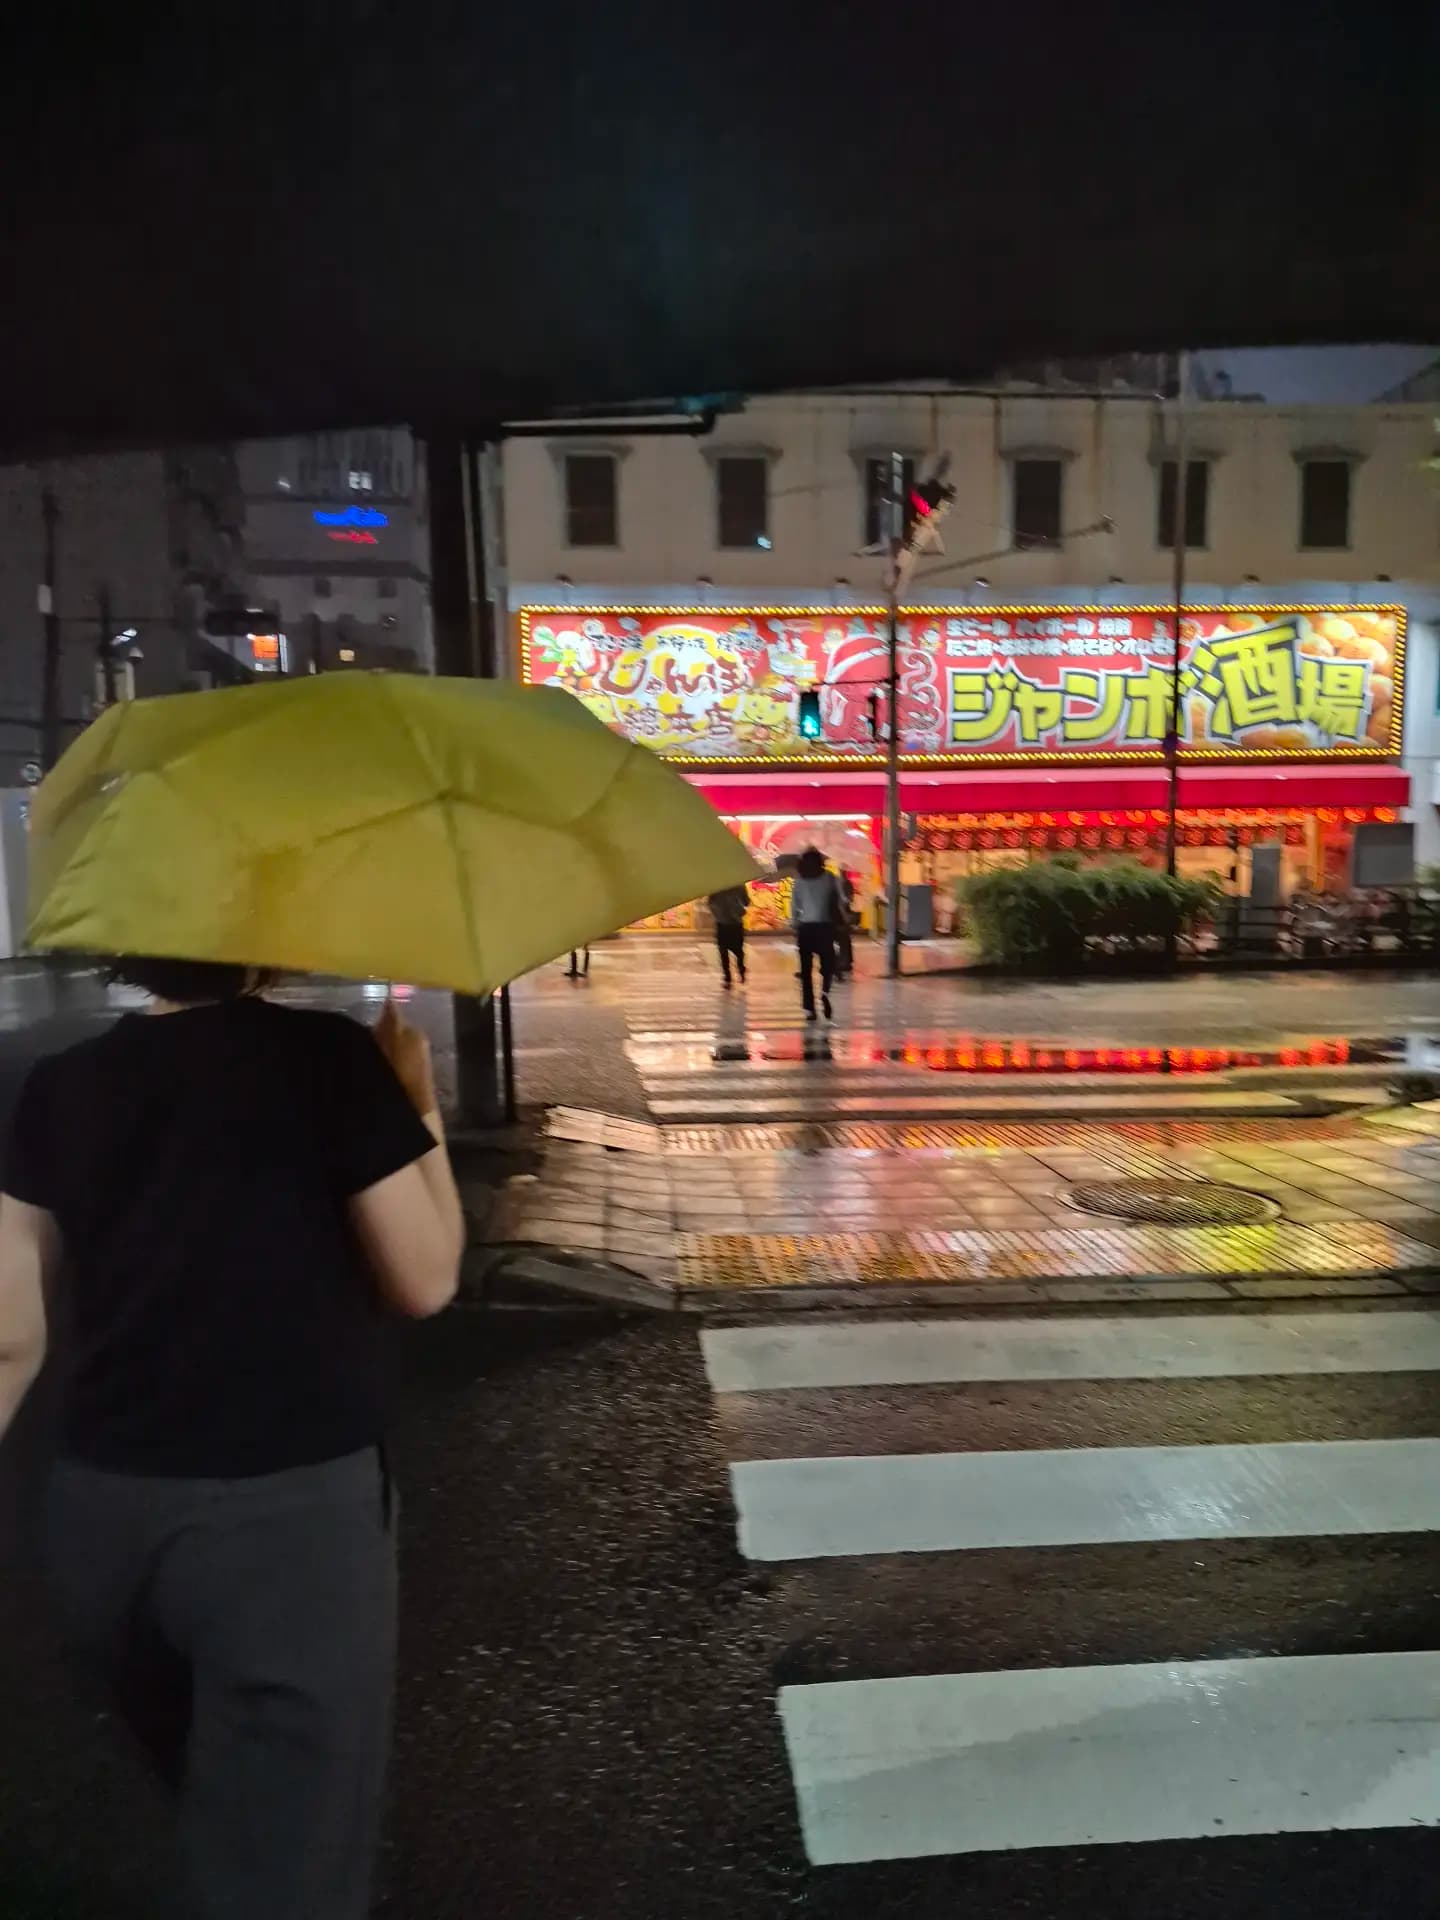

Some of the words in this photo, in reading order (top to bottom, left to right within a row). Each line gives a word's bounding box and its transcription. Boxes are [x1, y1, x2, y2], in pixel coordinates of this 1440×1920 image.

[951, 622, 1366, 742] ジャンボ酒場
